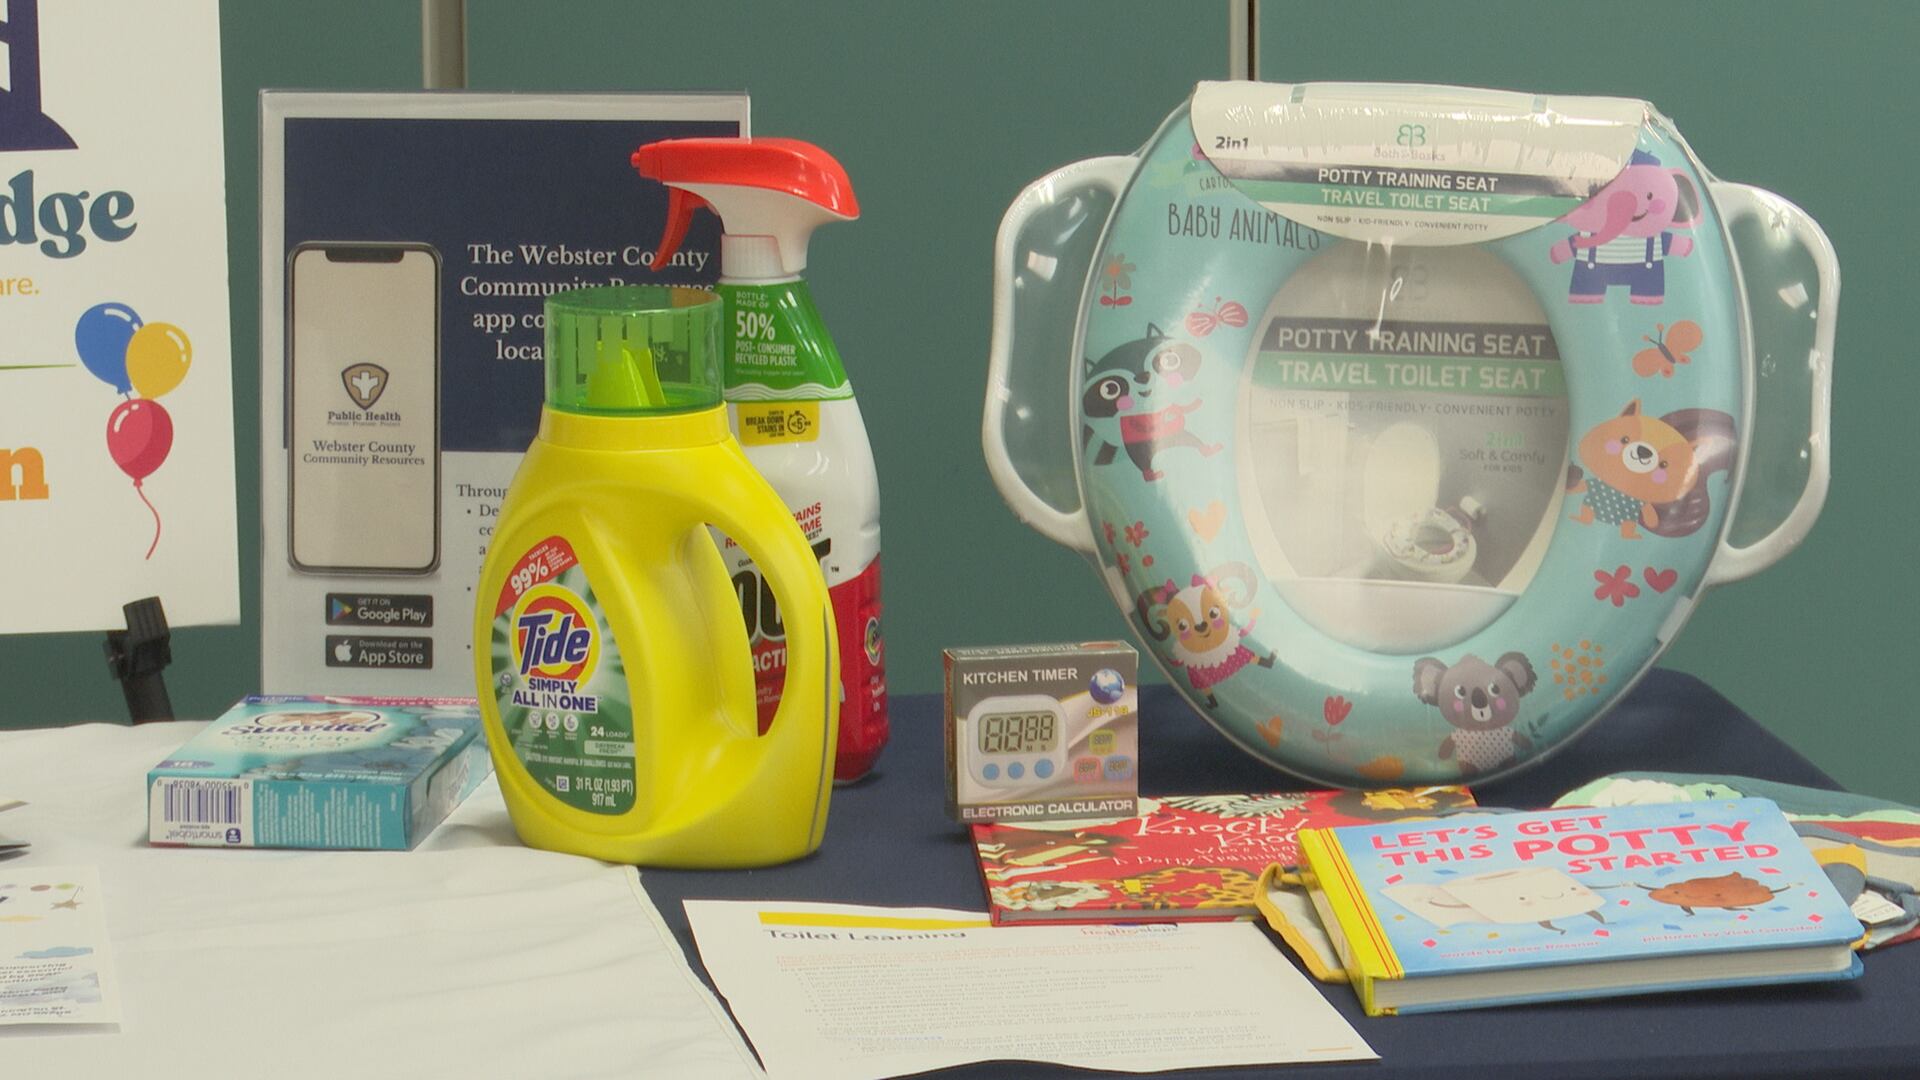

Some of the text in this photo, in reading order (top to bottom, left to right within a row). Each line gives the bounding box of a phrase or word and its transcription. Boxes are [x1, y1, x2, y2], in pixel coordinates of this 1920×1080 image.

[1215, 136, 1249, 149] 2in1
[1318, 168, 1499, 192] POTTY TRAINING SEAT
[1321, 188, 1492, 212] TRAVEL TOILET SEAT
[1168, 203, 1221, 239] BABY
[1414, 221, 1461, 230] CONVENIENT
[1463, 223, 1489, 231] POTTY
[467, 243, 709, 272] The Webster Conty
[473, 313, 515, 333] app
[735, 310, 776, 341] 50%
[758, 343, 796, 356] CONSUMER
[1278, 327, 1545, 356] POTTY TRAINING SEAT
[735, 353, 797, 367] RECYCLED PLASTIC
[1278, 360, 1545, 390] TRAVEL TOILET SEAT
[328, 411, 402, 422] Public Health
[1435, 403, 1513, 417] CONVENIENT
[746, 416, 766, 426] BREAK
[767, 415, 784, 425] DOWN
[757, 424, 776, 434] STAINS
[313, 440, 416, 456] Webster County
[303, 453, 425, 466] Community Resources
[1459, 449, 1545, 465] Soft & Comfy
[793, 502, 822, 522] AINS
[511, 556, 550, 597] 99%
[358, 598, 371, 606] GET
[358, 608, 427, 624] Google Play
[359, 640, 423, 649] Download on the
[518, 614, 592, 676] Tide
[359, 650, 424, 667] App Store
[963, 668, 1078, 686] KITCHEN TIMER
[529, 678, 577, 694] SIMPLY
[513, 690, 596, 712] ALL IN ONE
[590, 725, 605, 738] 24
[576, 777, 634, 796] 31 FL OZ (1.93 PT)
[592, 792, 605, 806] 917
[963, 799, 1133, 819] ELECTRONIC CALCULATOR
[1371, 815, 1608, 850] LET'S GET
[1381, 820, 1750, 867] THIS POTTY
[1136, 856, 1196, 867] Potty
[1567, 844, 1779, 874] STARTED
[763, 928, 967, 944] Toilet Learning
[1641, 933, 1701, 944] pictures
[1703, 931, 1721, 940] by
